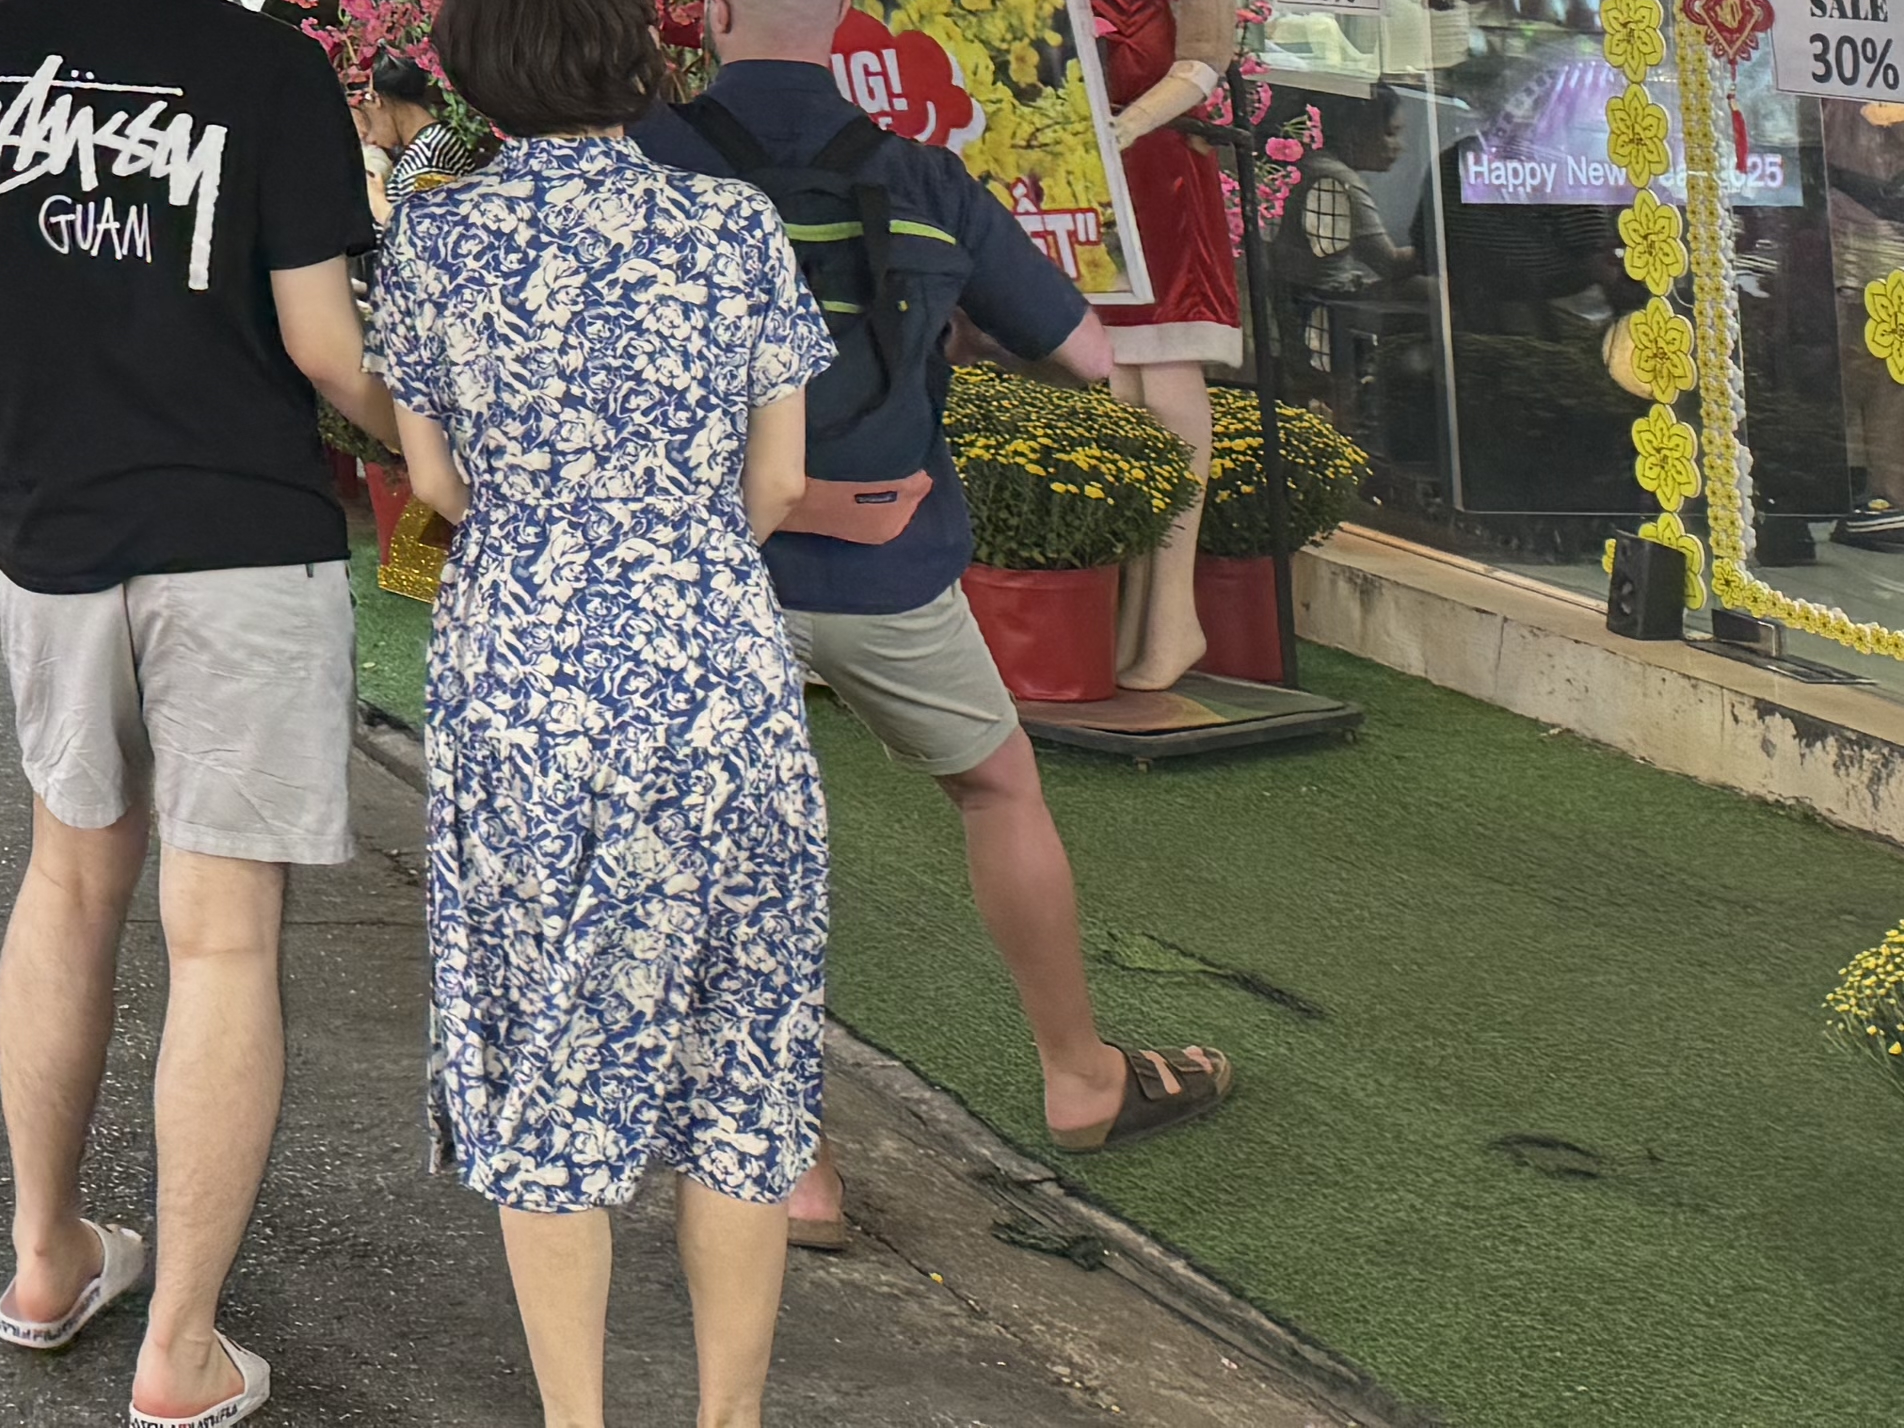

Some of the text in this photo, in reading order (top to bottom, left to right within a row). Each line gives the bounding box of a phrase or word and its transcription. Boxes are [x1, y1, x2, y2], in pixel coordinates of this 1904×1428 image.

[1809, 32, 1900, 90] 30%
[1467, 150, 1557, 193] Happy
[1567, 154, 1626, 186] New
[38, 194, 154, 263] GUAM
